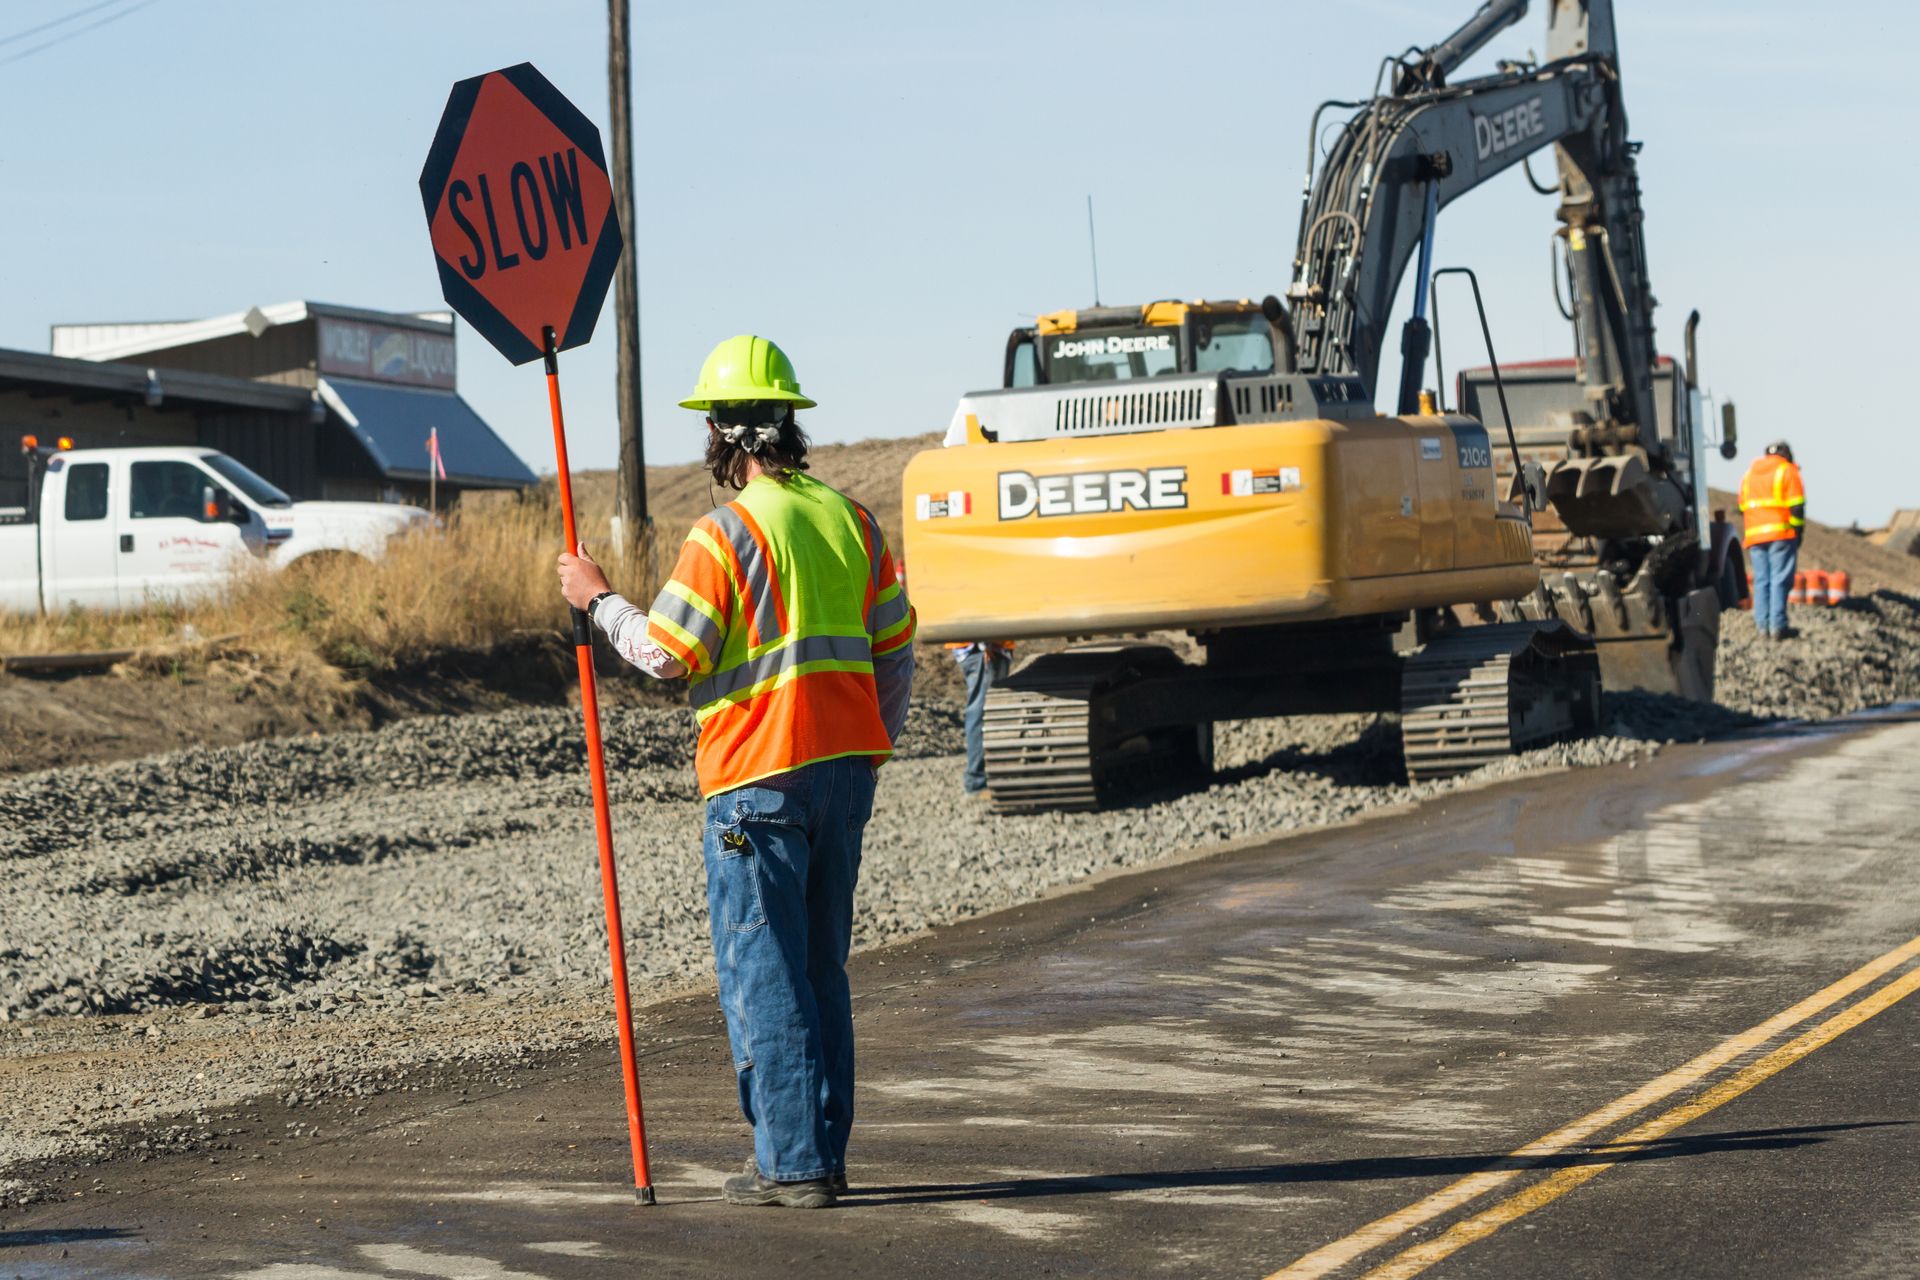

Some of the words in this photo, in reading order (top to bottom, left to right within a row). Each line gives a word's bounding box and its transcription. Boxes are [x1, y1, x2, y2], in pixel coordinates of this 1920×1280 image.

[1474, 97, 1543, 161] DEERE
[448, 148, 588, 280] SLOW
[1053, 339, 1104, 358] JOHN
[1107, 335, 1170, 354] DEERE
[1461, 447, 1488, 467] 210G
[998, 466, 1188, 521] DEERE
